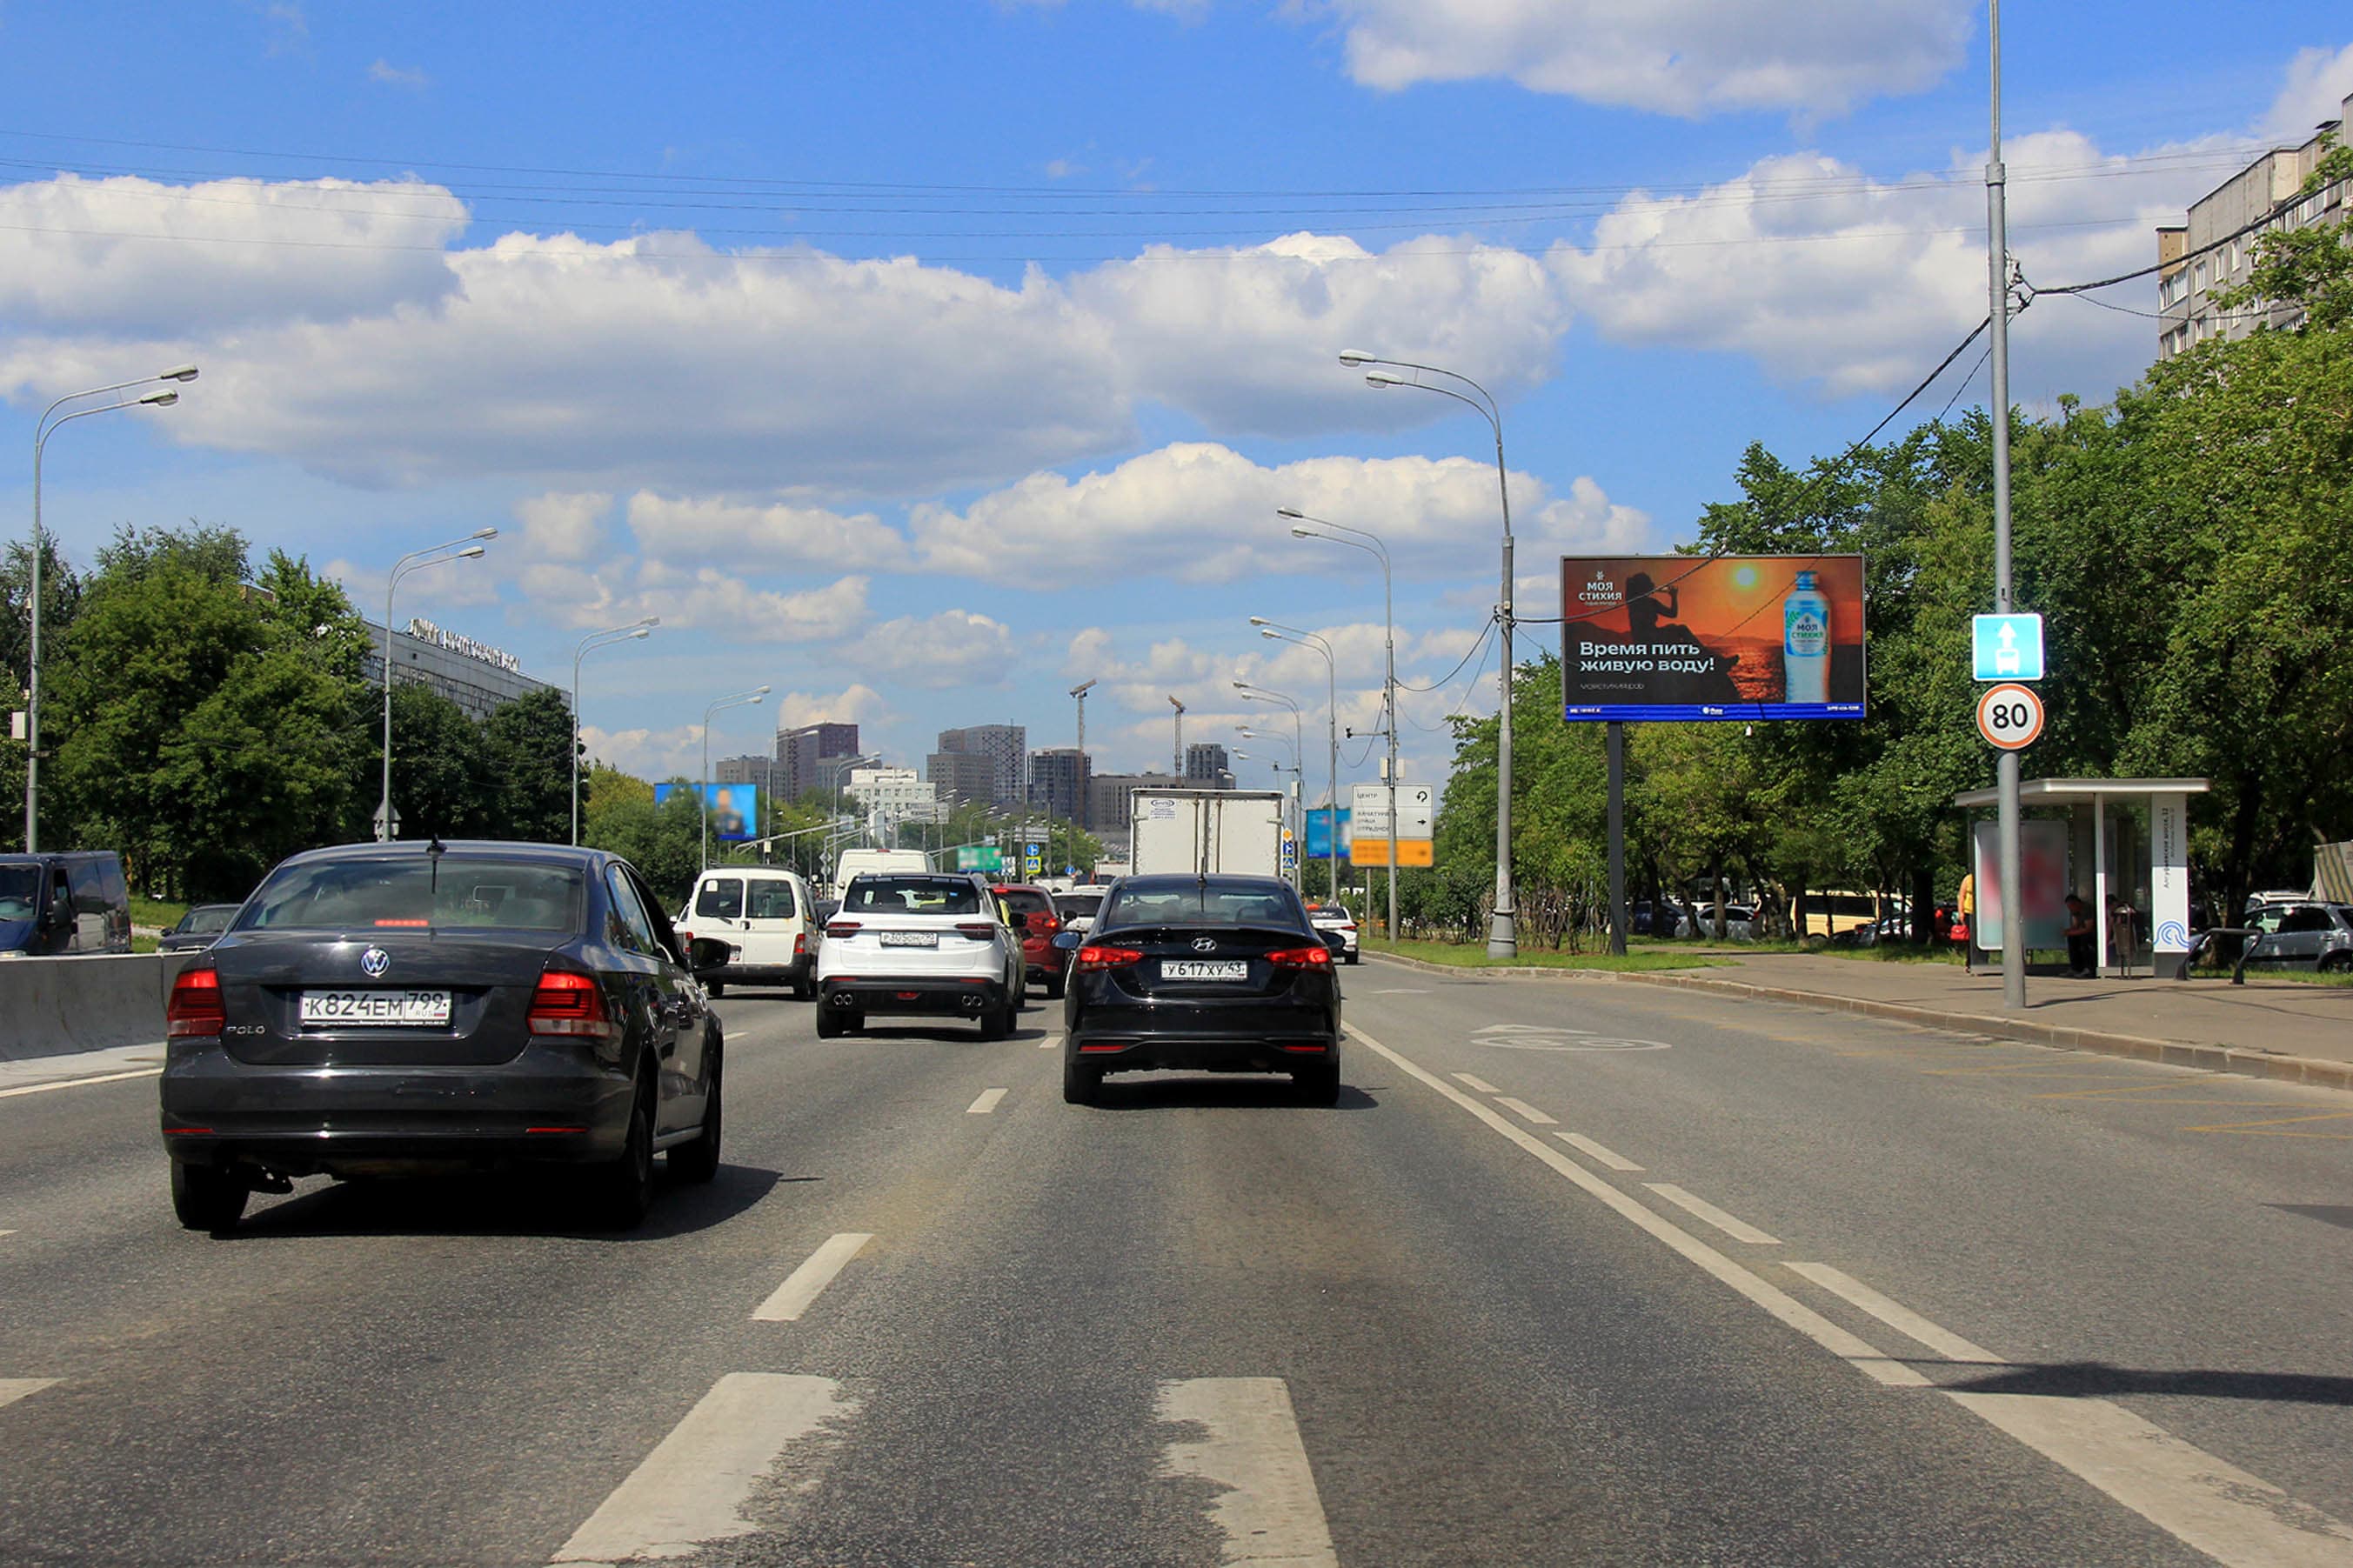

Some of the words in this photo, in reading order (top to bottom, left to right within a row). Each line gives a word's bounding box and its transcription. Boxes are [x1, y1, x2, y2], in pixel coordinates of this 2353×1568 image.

[1587, 582, 1614, 591] МОЯ
[1579, 592, 1622, 601] СТИХИЯ
[1580, 642, 1647, 657] Время
[1652, 644, 1701, 655] пить
[1580, 660, 1654, 674] живую
[1658, 657, 1715, 674] воду!
[1992, 704, 2029, 729] 80
[1227, 962, 1241, 972] 43
[309, 993, 404, 1016] К824ЕМ
[408, 992, 444, 1010] 799
[227, 1025, 265, 1035] POLO
